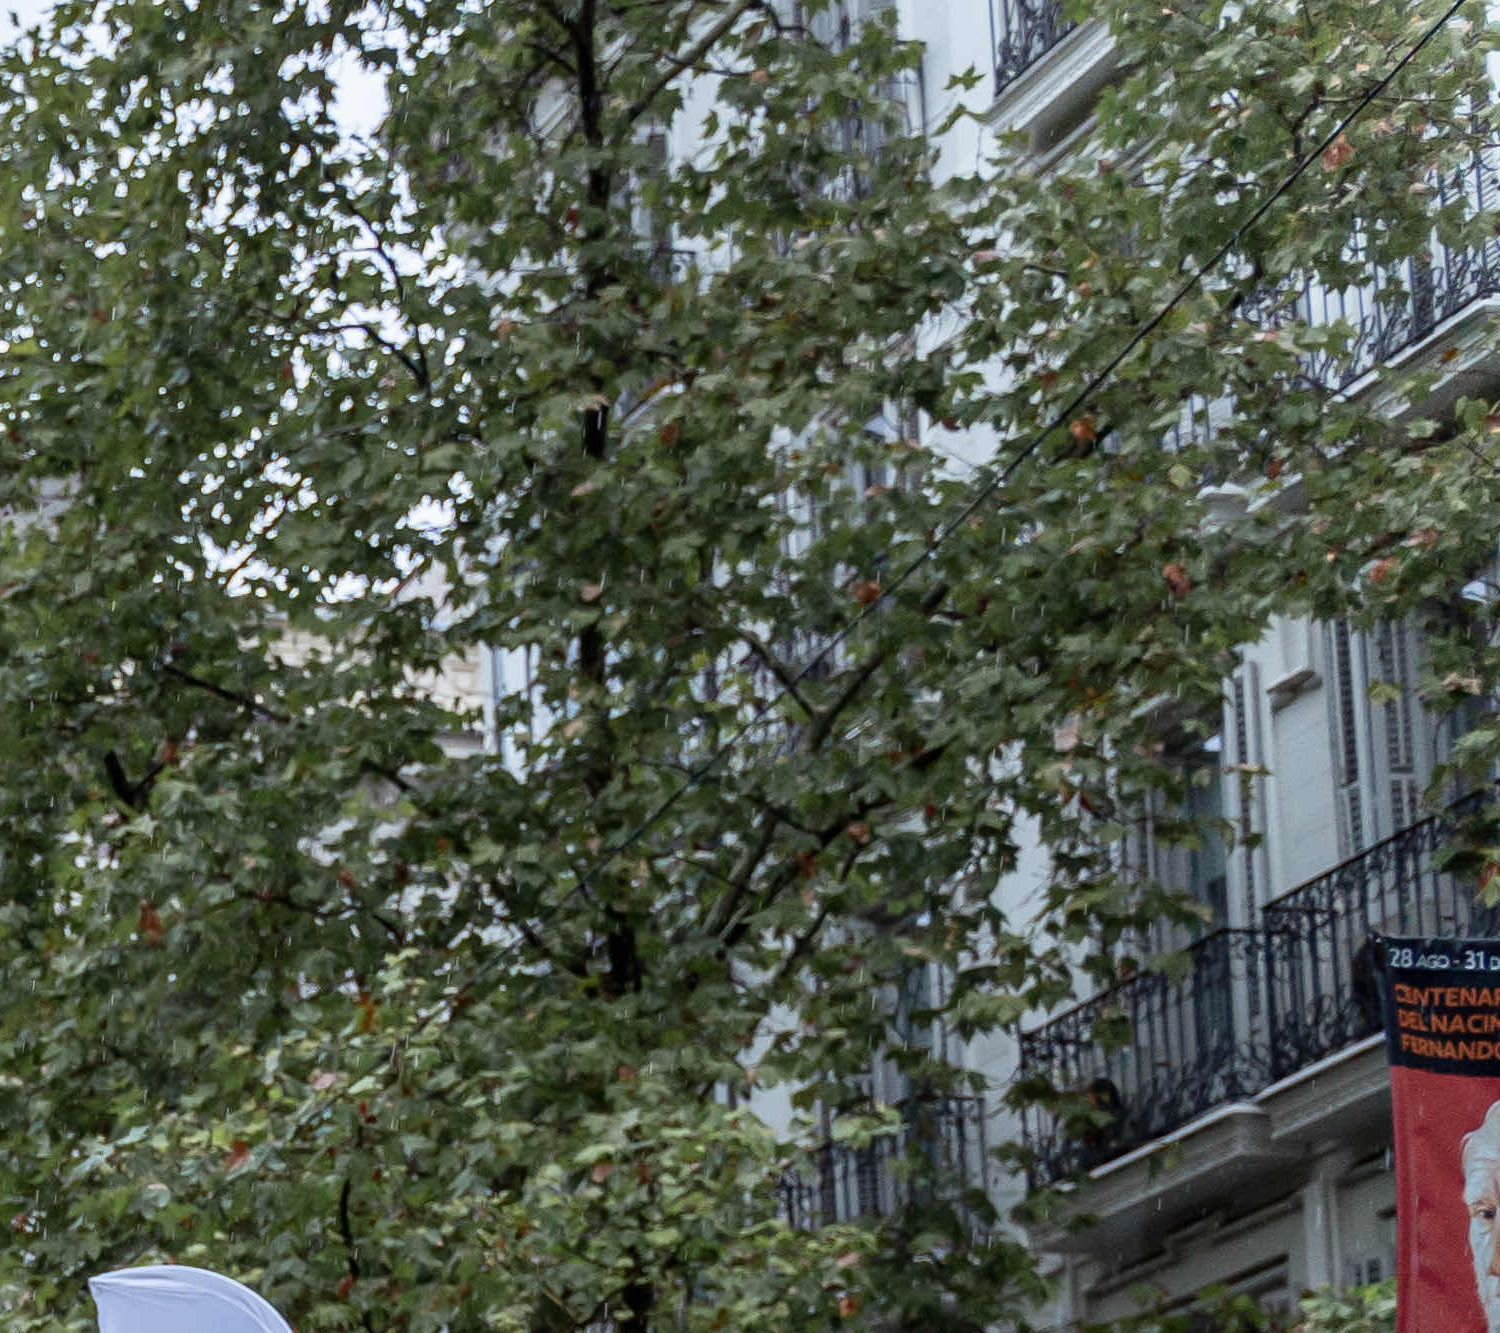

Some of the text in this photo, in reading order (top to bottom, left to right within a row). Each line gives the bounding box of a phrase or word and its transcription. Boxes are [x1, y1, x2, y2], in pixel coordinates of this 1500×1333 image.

[1388, 947, 1413, 968] 28
[1415, 954, 1450, 969] AGO
[1464, 949, 1486, 970] 31
